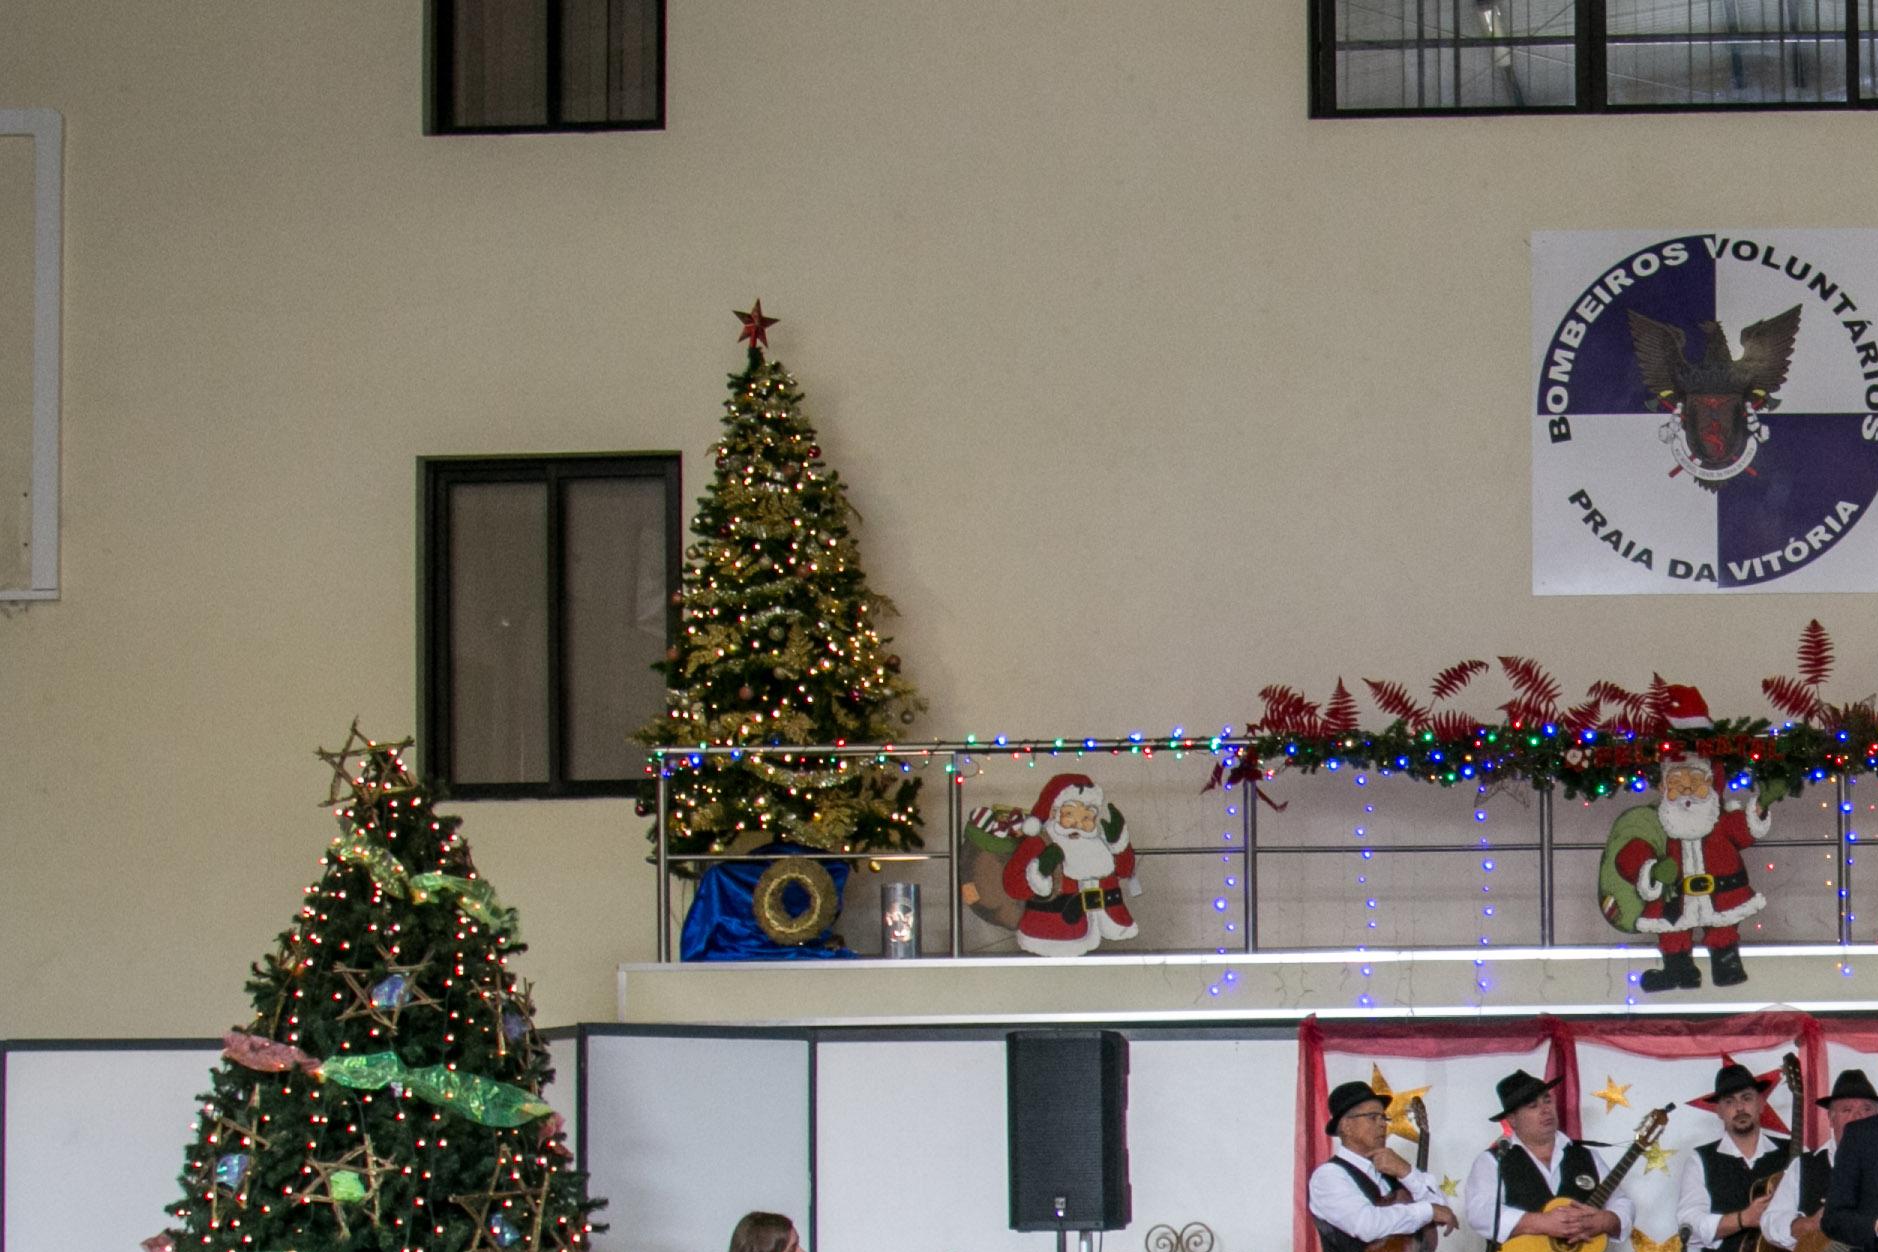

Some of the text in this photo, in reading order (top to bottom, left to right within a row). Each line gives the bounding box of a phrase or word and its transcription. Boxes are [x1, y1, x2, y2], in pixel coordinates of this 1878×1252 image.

[1545, 241, 1690, 443] BOMBEIROS
[1567, 487, 1860, 583] PRAIA DA VITÓRIA
